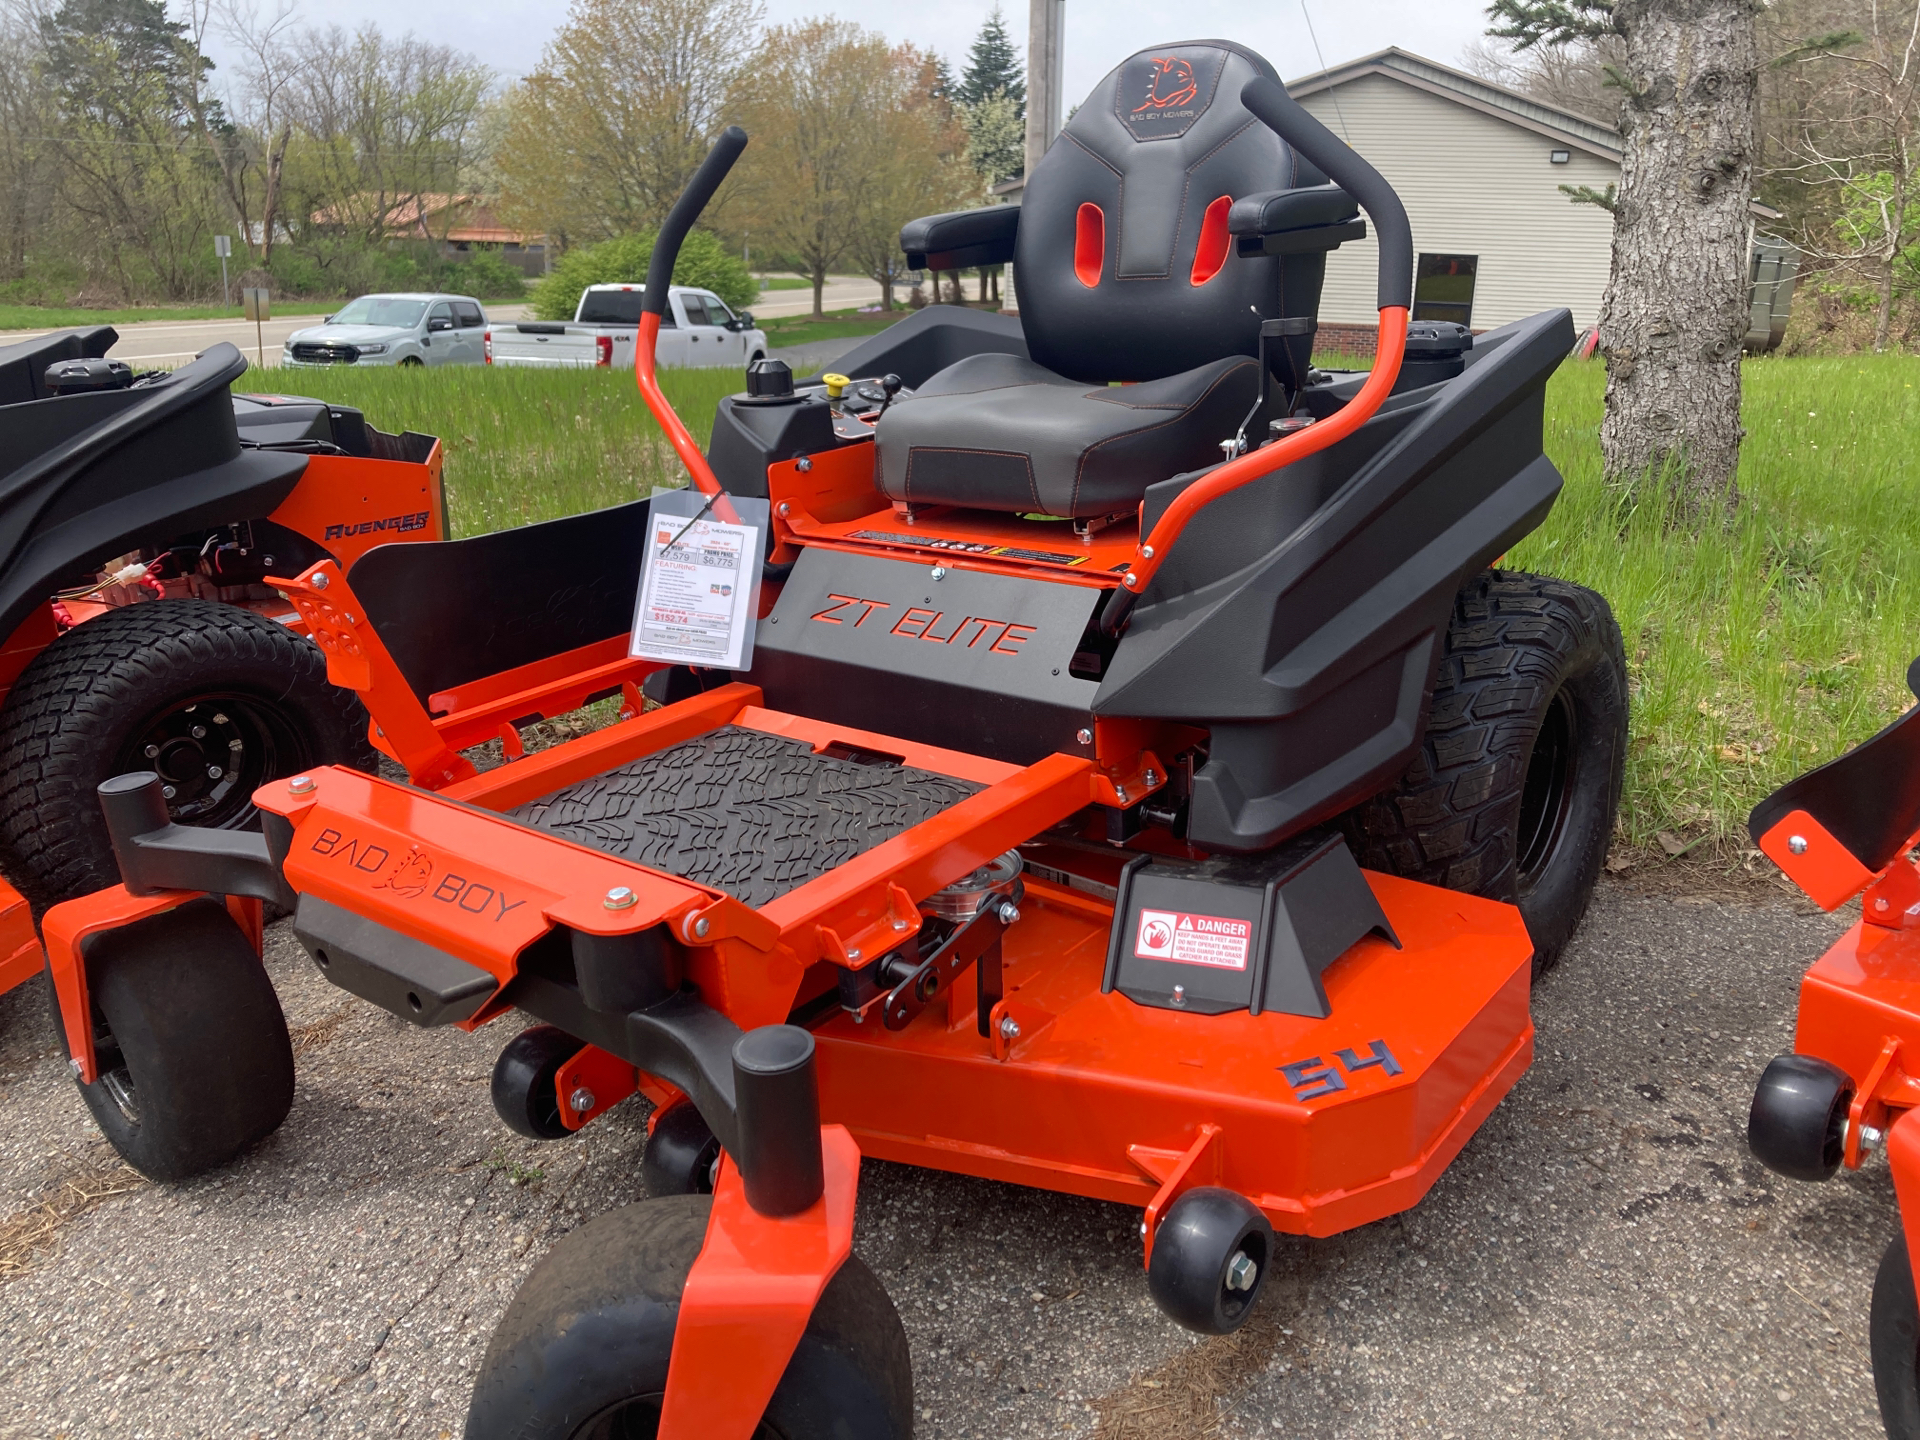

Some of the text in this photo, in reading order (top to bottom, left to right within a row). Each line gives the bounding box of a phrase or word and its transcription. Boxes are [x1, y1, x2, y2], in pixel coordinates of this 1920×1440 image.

[1163, 110, 1194, 118] MOWERS
[703, 556, 732, 567] $6,775
[654, 613, 687, 623] $152.74
[810, 594, 1037, 656] ZT ELITE
[311, 828, 527, 922] BAD BOY
[1197, 919, 1246, 935] DANGER
[1198, 941, 1220, 949] OPERATE
[1222, 943, 1242, 951] MOWER
[1179, 952, 1202, 960] CATCHER
[1225, 951, 1242, 959] GRASS
[1274, 1039, 1404, 1102] 54
